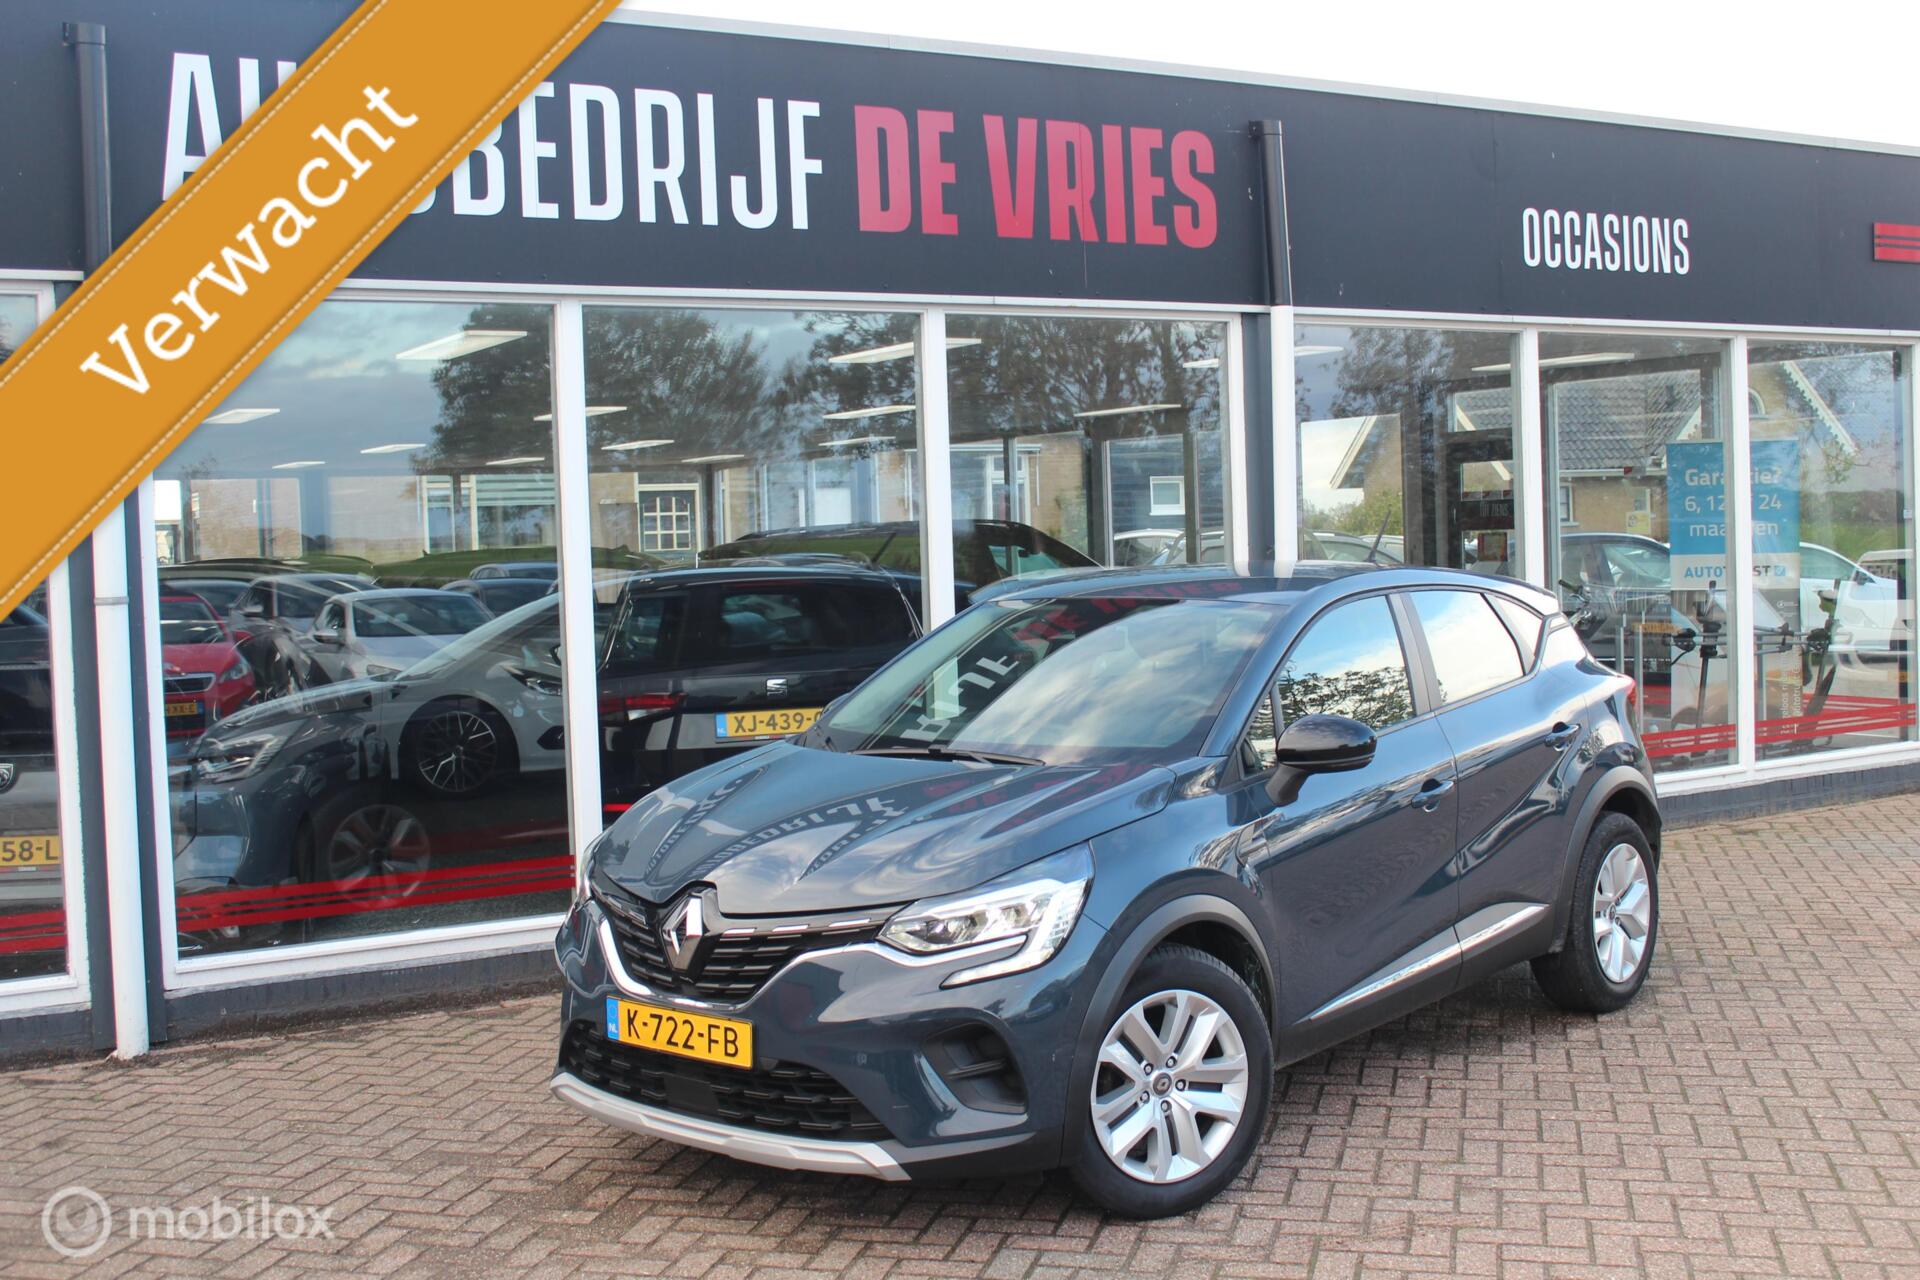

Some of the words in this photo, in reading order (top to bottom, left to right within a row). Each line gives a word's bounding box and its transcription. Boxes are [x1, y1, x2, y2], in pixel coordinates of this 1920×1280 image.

[855, 105, 958, 235] DE
[983, 114, 1218, 249] VRIES
[1523, 207, 1690, 275] OCCASIONS
[1685, 496, 1700, 513] 6,
[1759, 494, 1782, 510] 24
[1690, 523, 1778, 537] maaen
[1684, 565, 1771, 577] AUTOST
[627, 1008, 739, 1058] K-722-FB
